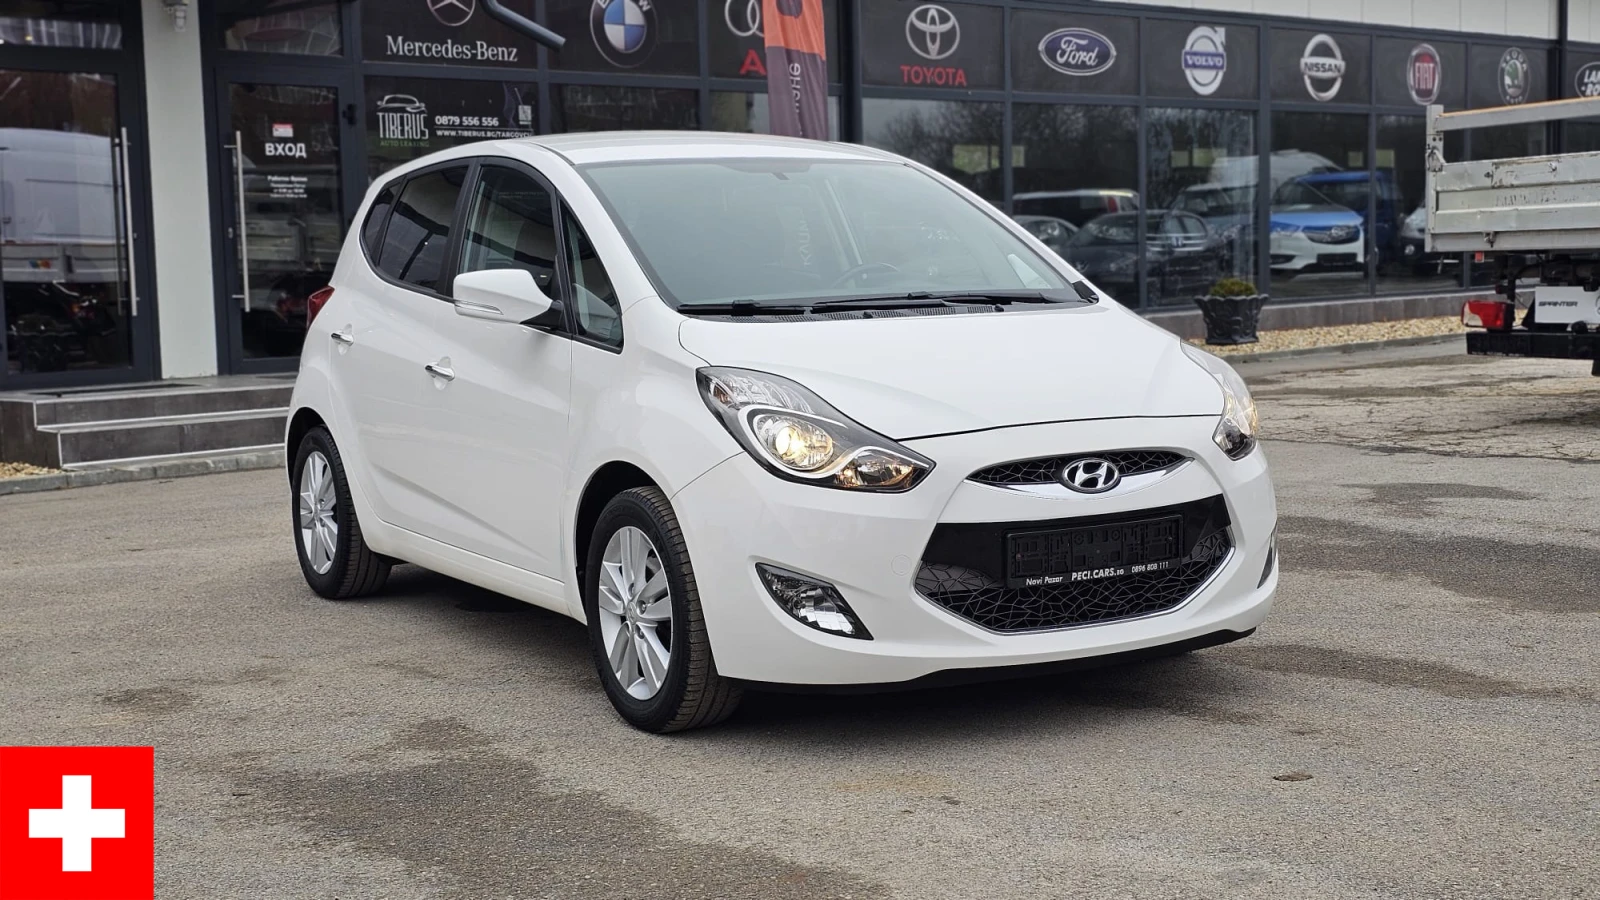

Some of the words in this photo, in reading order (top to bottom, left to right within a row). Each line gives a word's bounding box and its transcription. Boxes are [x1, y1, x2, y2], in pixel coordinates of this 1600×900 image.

[386, 35, 518, 62] Mercedes-Benz
[1056, 36, 1099, 66] Ford
[1185, 54, 1224, 67] VOLVO
[1304, 61, 1342, 74] NISSAN
[900, 65, 967, 86] TOYOTA
[1414, 62, 1435, 90] FIAT
[376, 112, 430, 140] TIBERUS
[435, 115, 460, 125] 0879
[462, 116, 480, 126] 556
[482, 117, 500, 127] 556
[265, 142, 307, 158] ВХОД
[1026, 577, 1043, 586] Novi
[1044, 576, 1063, 584] Pazar
[1131, 565, 1146, 573] 0896
[1147, 563, 1158, 571] 808
[1160, 561, 1169, 569] 111
